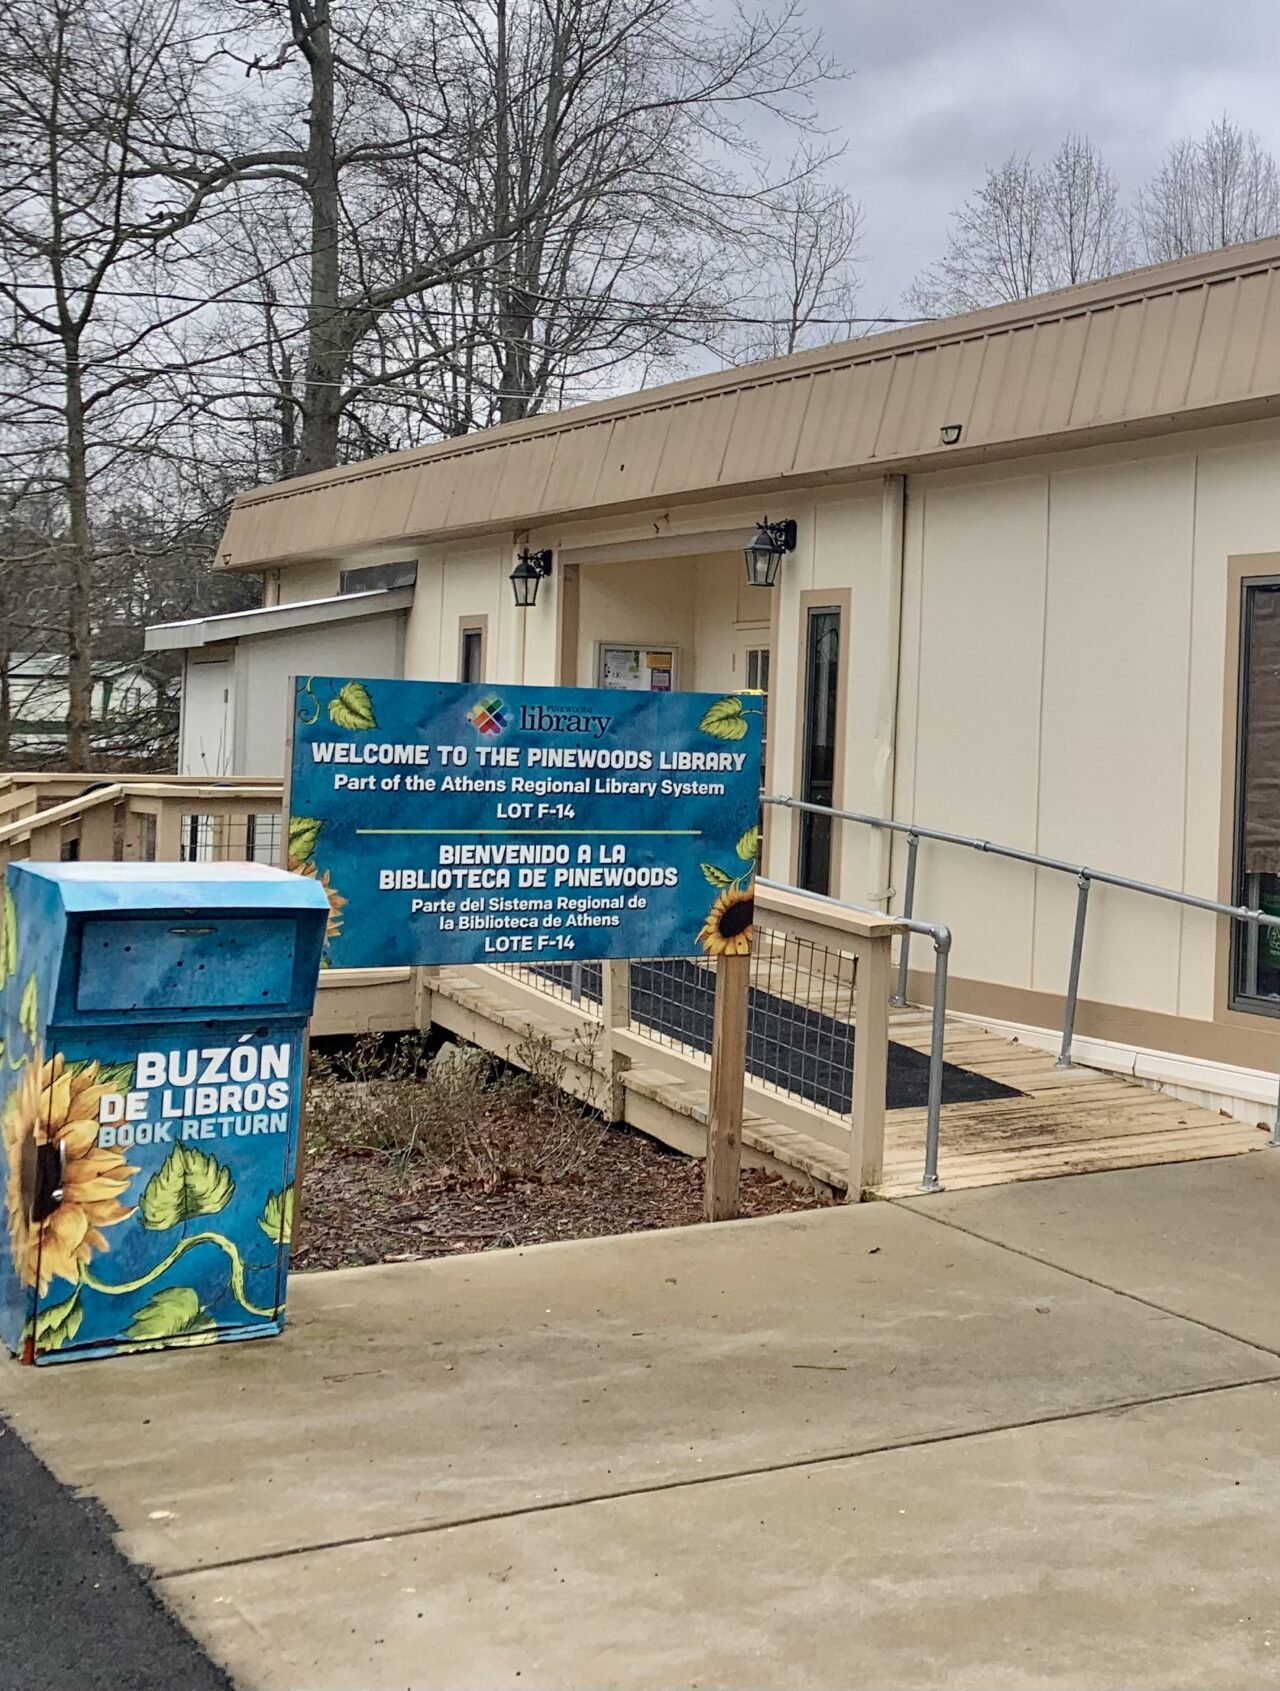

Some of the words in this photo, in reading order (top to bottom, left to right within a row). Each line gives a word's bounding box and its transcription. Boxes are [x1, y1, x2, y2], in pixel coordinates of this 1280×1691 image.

[546, 704, 593, 714] PINEWOODS
[519, 705, 612, 739] library
[311, 742, 430, 765] WELCOME
[436, 745, 468, 766] TO
[475, 746, 520, 767] THE
[527, 748, 653, 770] PINEWOODS
[659, 751, 746, 771] LIBRARY
[334, 773, 377, 791] Part
[380, 774, 402, 791] of
[404, 775, 436, 791] the
[440, 776, 507, 793] Athens
[511, 777, 591, 796] Regional
[595, 778, 657, 797] Library
[660, 779, 725, 798] System
[497, 802, 534, 819] LOT
[537, 803, 576, 819] F-14
[438, 844, 570, 865] BIENVENIDO
[577, 844, 592, 864] A
[599, 844, 626, 864] LA
[379, 868, 511, 890] BIBLIOTECA
[518, 868, 548, 888] DE
[554, 866, 678, 888] PINEWOODS
[411, 898, 456, 913] Parte
[459, 897, 485, 912] del
[488, 897, 553, 912] Sistema
[556, 895, 625, 913] Regional
[627, 895, 647, 909] de
[439, 915, 455, 930] la
[458, 913, 539, 930] Biblioteca
[542, 913, 562, 928] de
[565, 912, 620, 928] Athens
[484, 935, 533, 953] LOTE
[537, 934, 576, 951] F-14
[136, 1033, 291, 1089] BUZÓN
[99, 1091, 150, 1124] DE
[161, 1081, 290, 1119] LIBROS
[97, 1120, 173, 1149] BOOK
[181, 1112, 288, 1141] RETURN
